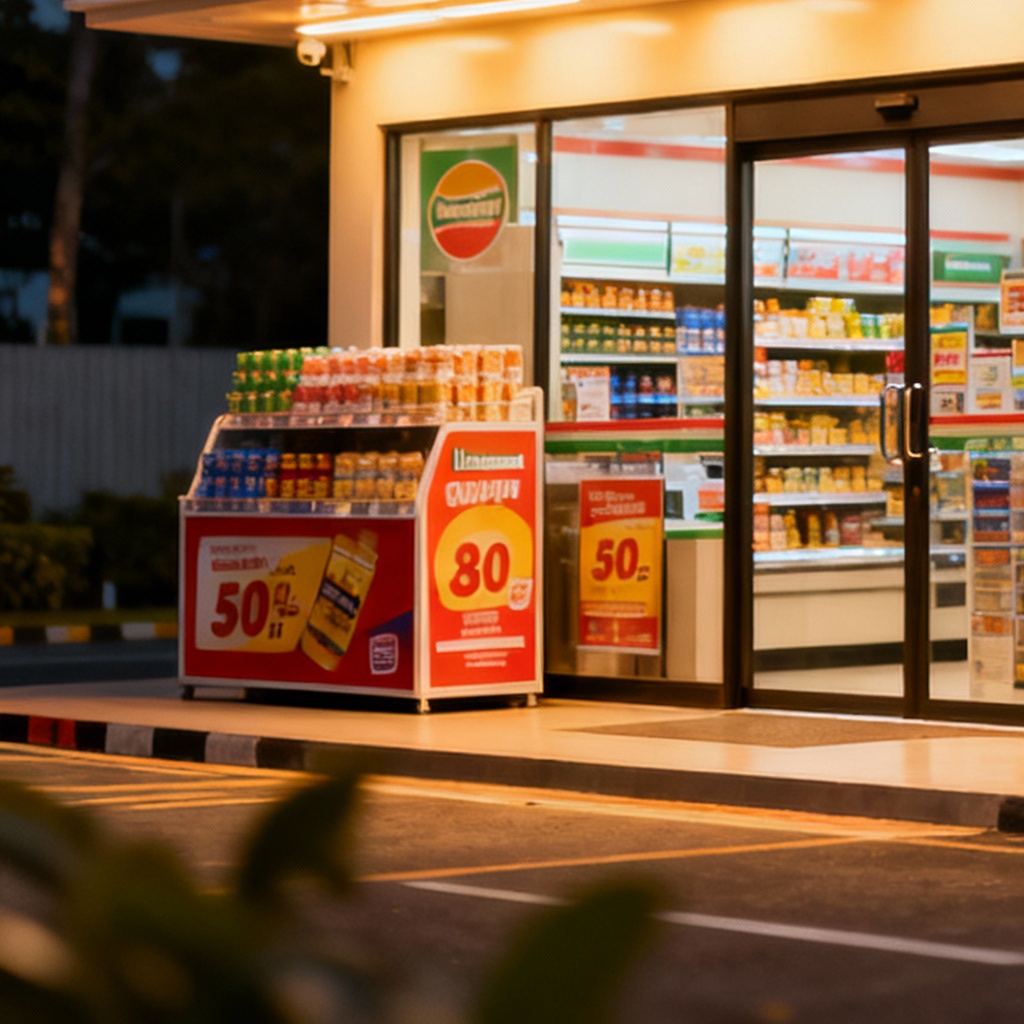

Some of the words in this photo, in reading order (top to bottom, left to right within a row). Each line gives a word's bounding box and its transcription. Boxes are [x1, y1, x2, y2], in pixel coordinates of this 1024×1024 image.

[449, 542, 510, 598] 80
[591, 538, 639, 581] 50
[211, 580, 269, 638] 50
